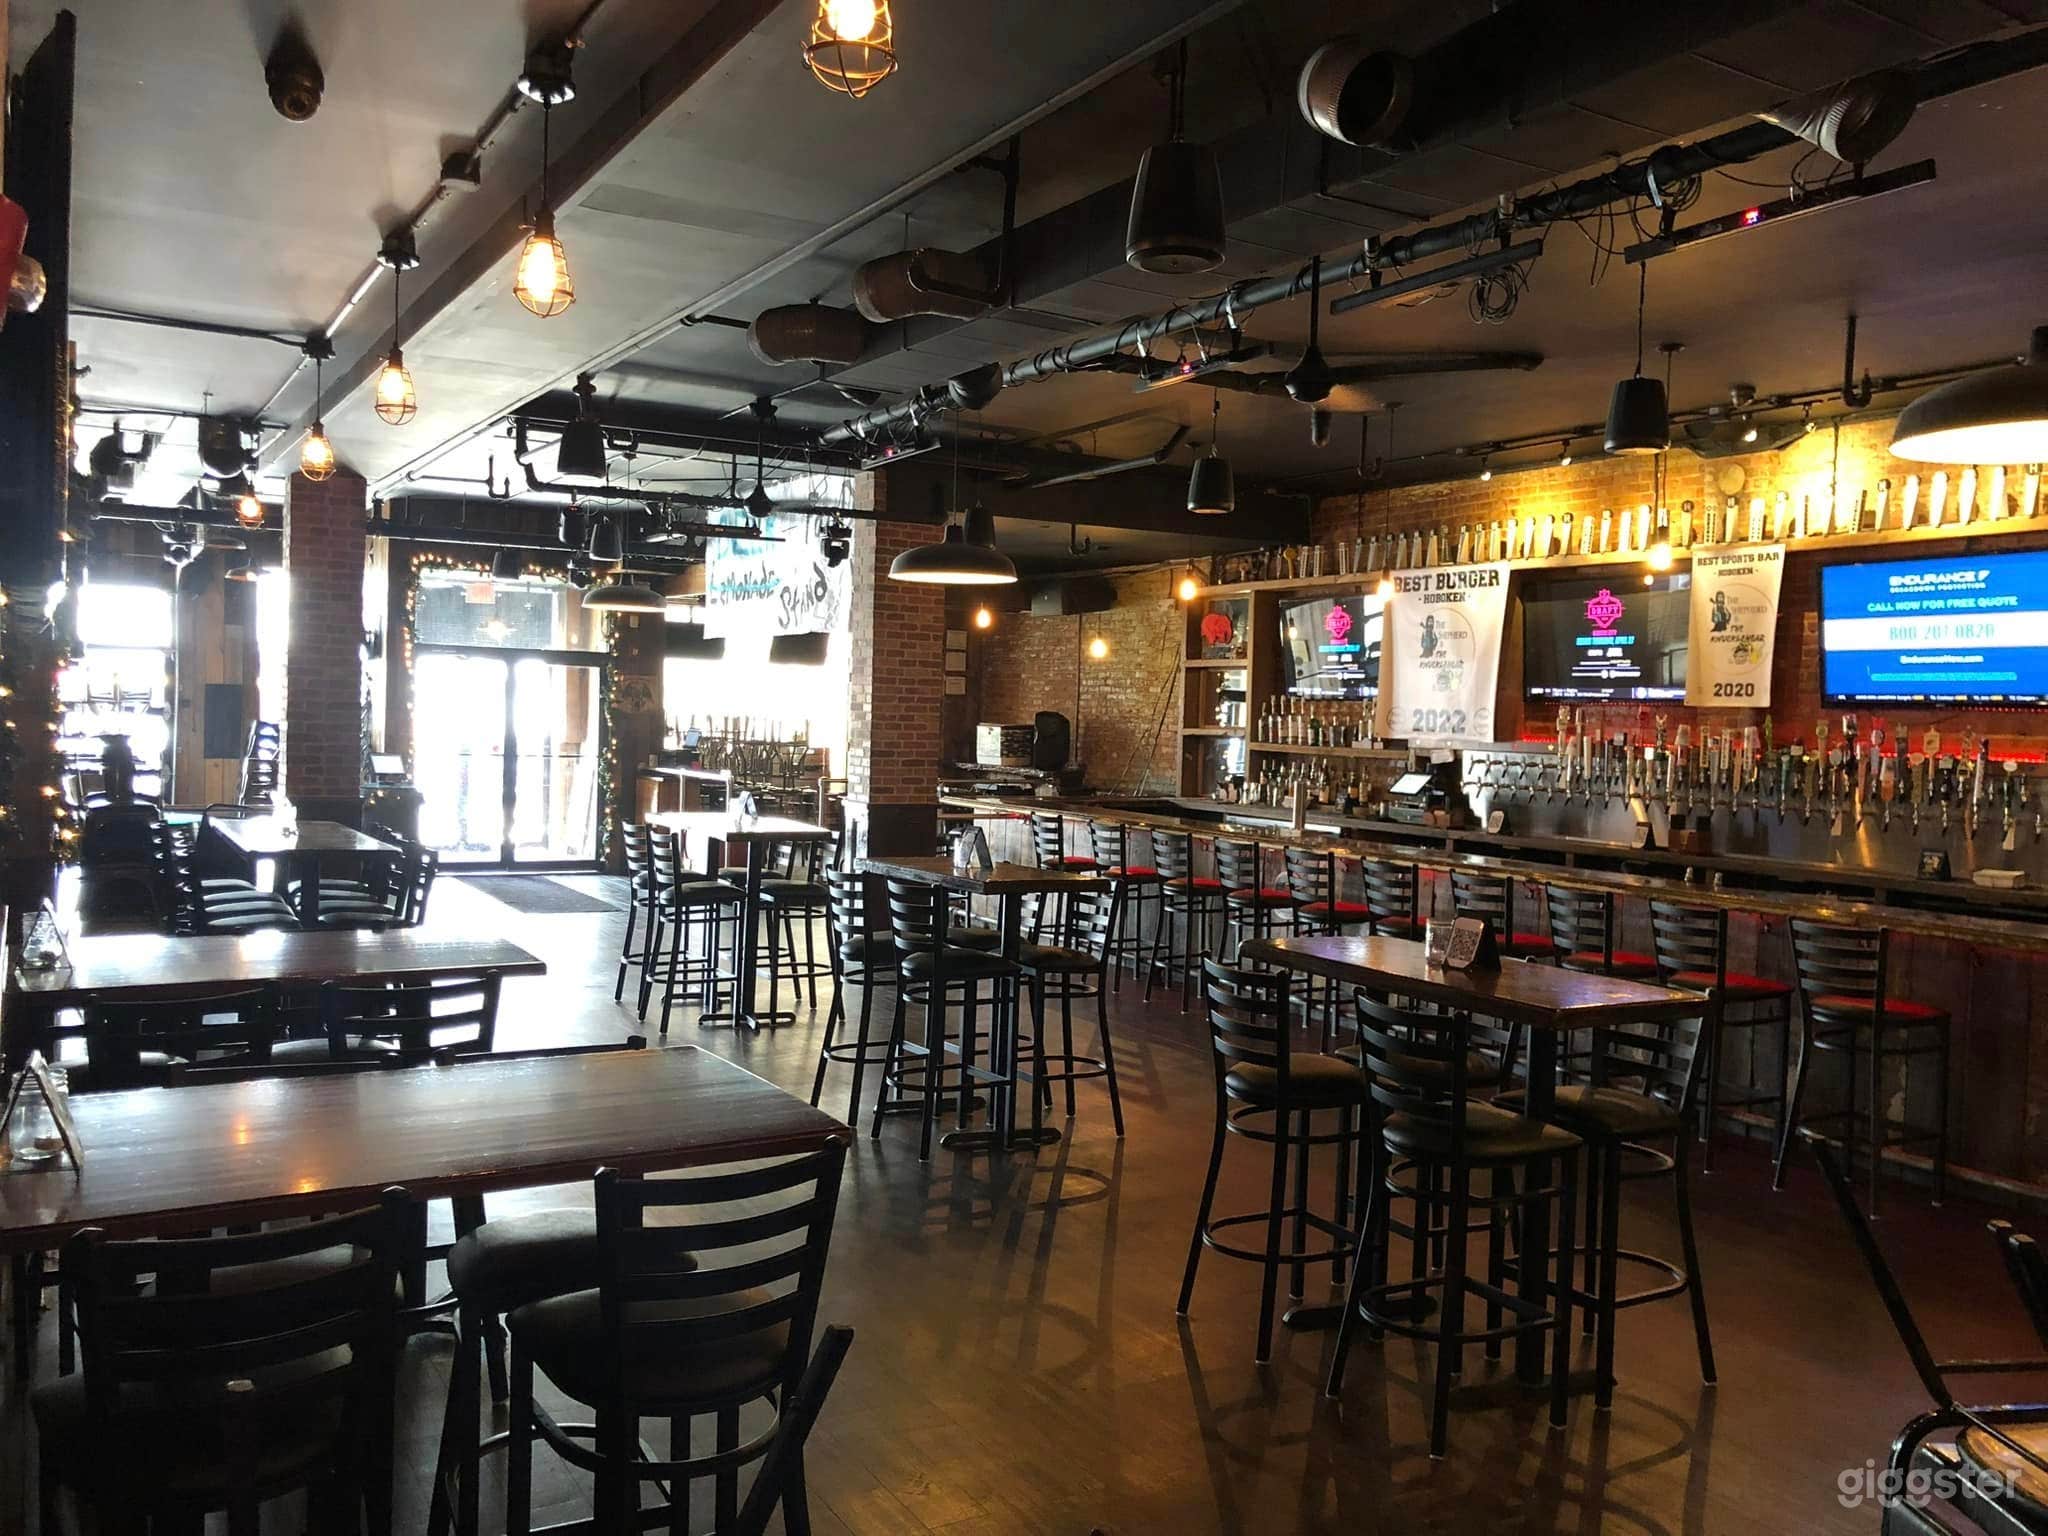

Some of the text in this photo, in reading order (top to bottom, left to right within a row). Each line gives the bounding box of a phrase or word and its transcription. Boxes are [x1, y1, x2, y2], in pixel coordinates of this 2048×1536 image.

[1698, 551, 1779, 566] BEST SPORTS BAR
[1394, 569, 1500, 593] BEST BURGER
[1889, 572, 1976, 587] ENDURANCE
[1423, 592, 1466, 604] HOBOKEN
[1867, 596, 2019, 612] CALL NOW FOR FREE QUOTE
[1591, 606, 1619, 615] DRAFT
[1713, 683, 1755, 697] 2020
[1412, 708, 1466, 734] 2022
